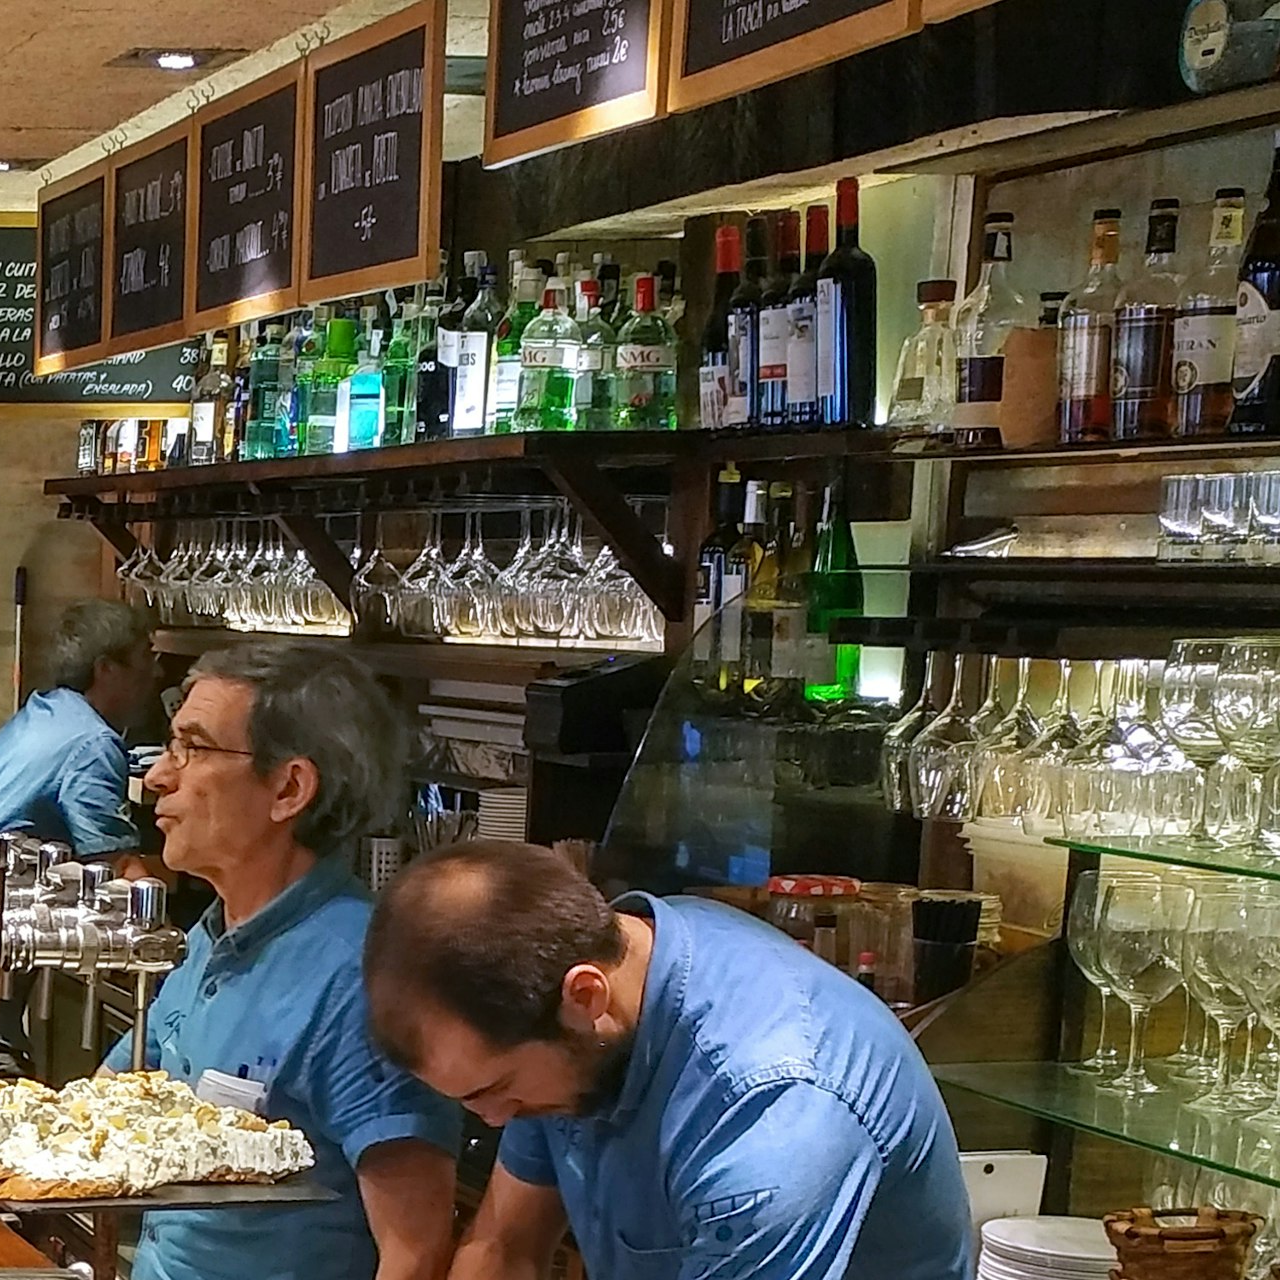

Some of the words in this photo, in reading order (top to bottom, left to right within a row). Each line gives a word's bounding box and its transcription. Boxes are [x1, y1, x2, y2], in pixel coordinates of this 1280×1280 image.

[0, 328, 8, 342] A
[12, 327, 32, 341] LA
[180, 348, 198, 364] 38
[82, 379, 153, 399] ENSALADA)
